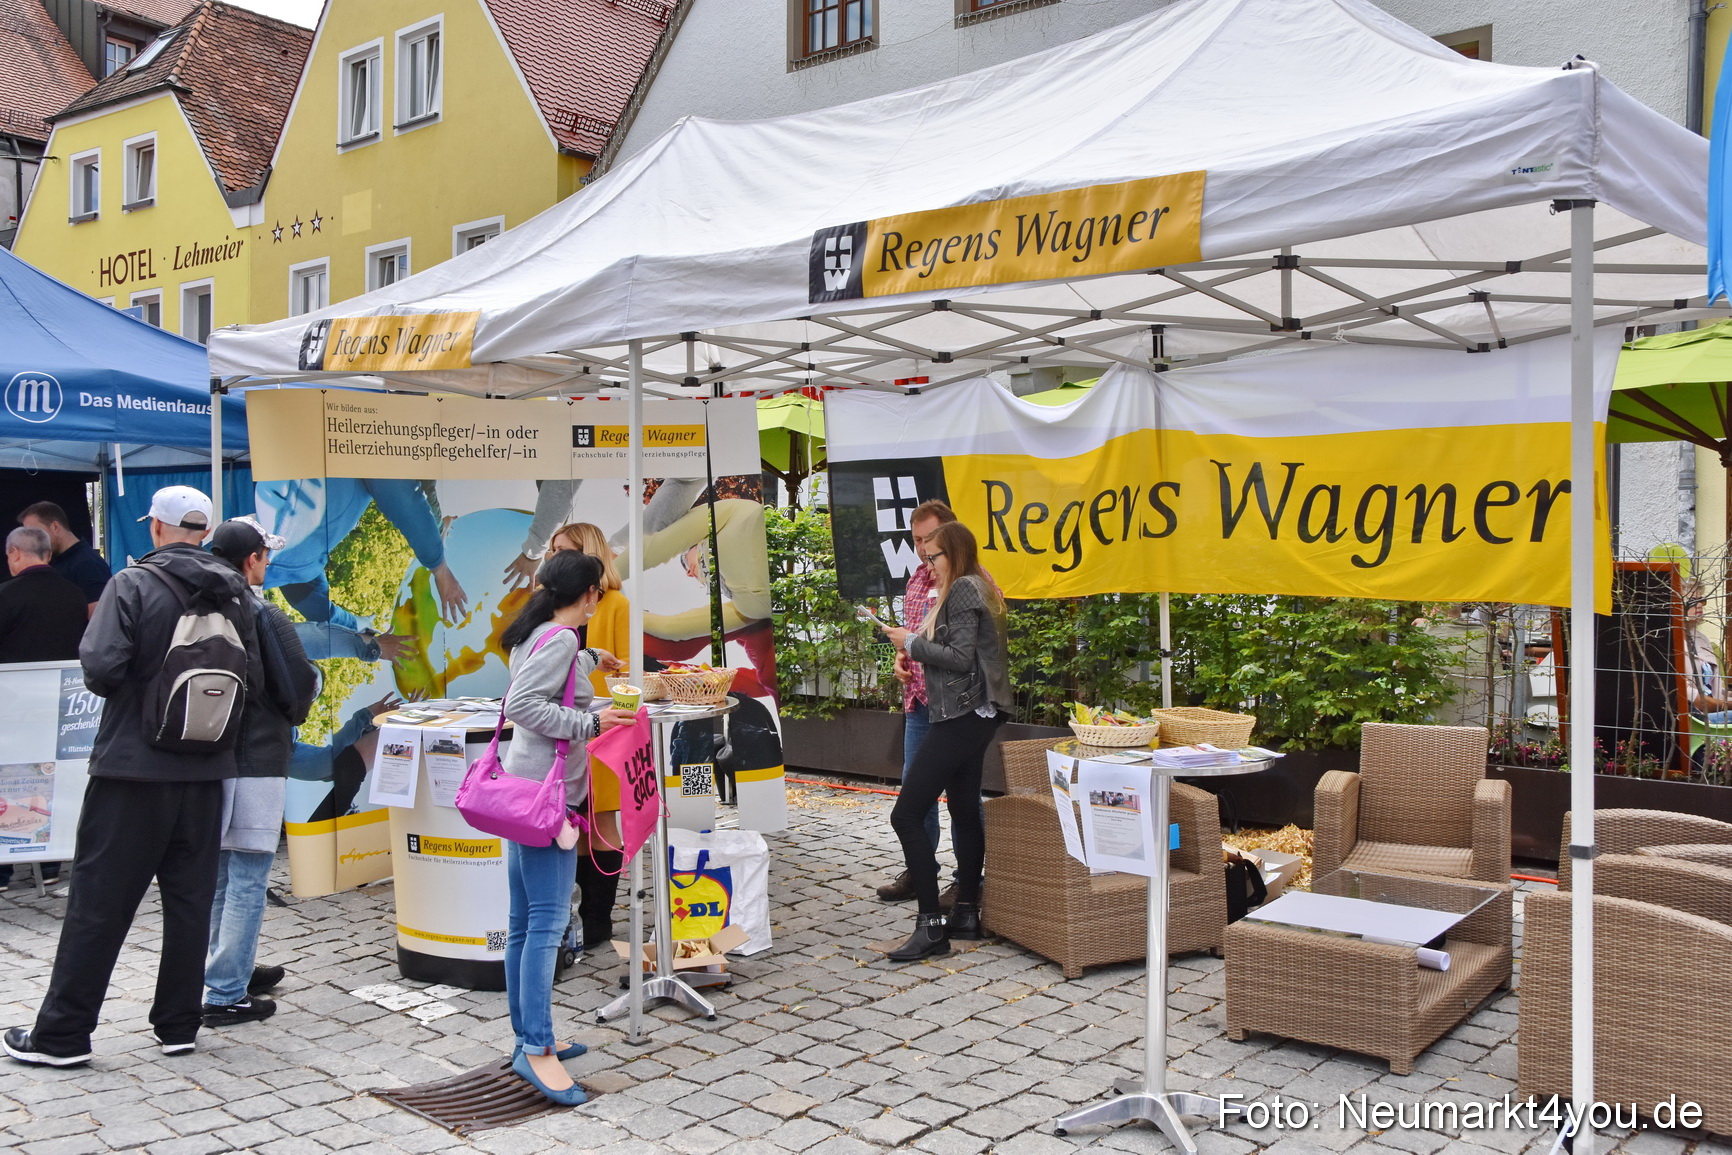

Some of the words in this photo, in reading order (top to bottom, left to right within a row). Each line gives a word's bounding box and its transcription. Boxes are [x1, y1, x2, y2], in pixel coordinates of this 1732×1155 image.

[877, 229, 1001, 278] Regens
[1015, 206, 1169, 263] Wagner
[100, 248, 156, 287] HOTEL
[172, 234, 244, 271] Lehmeier
[332, 329, 390, 362] Regens
[394, 326, 462, 362] Wagner
[80, 391, 113, 408] Das
[326, 402, 339, 411] Wir
[341, 404, 362, 413] bilden
[506, 426, 539, 440] oder
[600, 429, 644, 445] Rege
[647, 429, 697, 445] Wagner
[1210, 458, 1572, 569] Wagner
[64, 691, 101, 717] 150
[21, 777, 49, 785] Zeitung
[423, 838, 453, 853] Regens
[454, 842, 494, 856] Wagner
[408, 854, 432, 863] Fachschule
[442, 858, 503, 866] Heilerziehungspflege
[414, 931, 476, 945] www.regens-wagner.org
